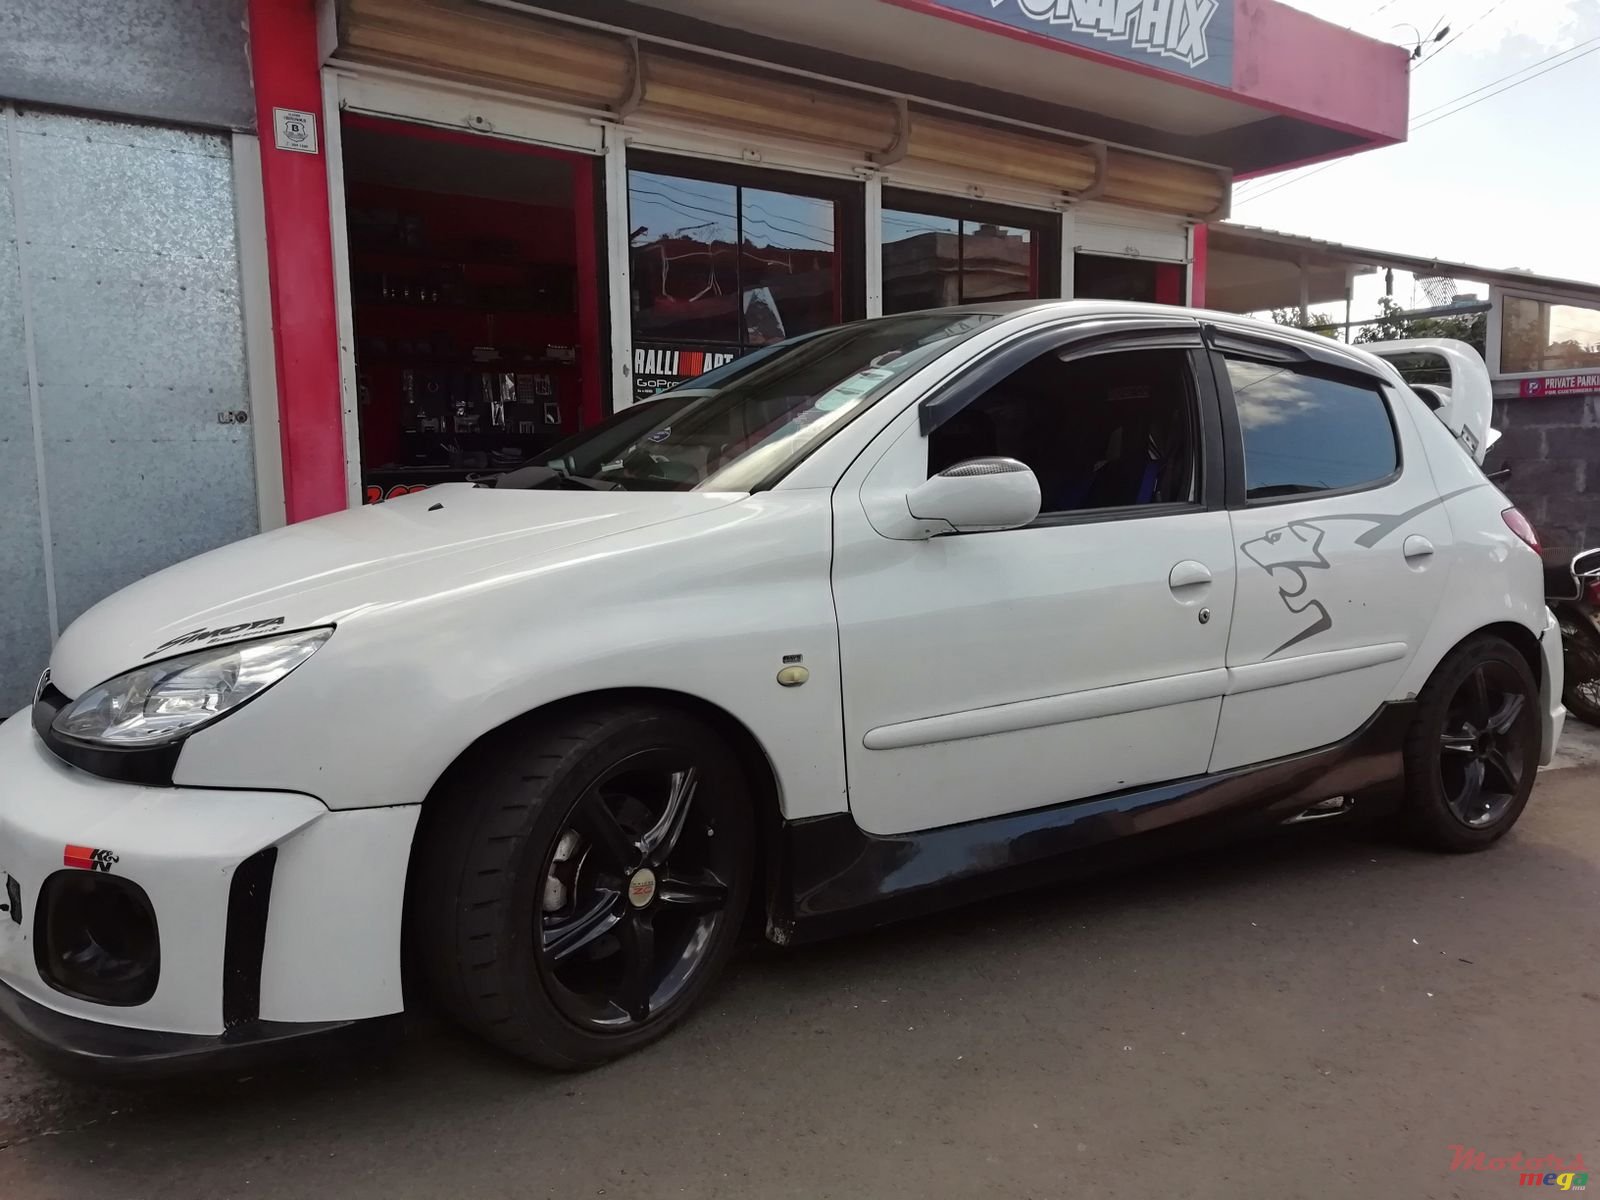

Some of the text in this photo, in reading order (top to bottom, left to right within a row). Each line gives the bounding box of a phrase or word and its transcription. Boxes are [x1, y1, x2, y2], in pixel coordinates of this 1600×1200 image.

[635, 349, 679, 376] RALLI
[1545, 376, 1576, 389] PRIVATE
[143, 616, 285, 660] SIMOTA
